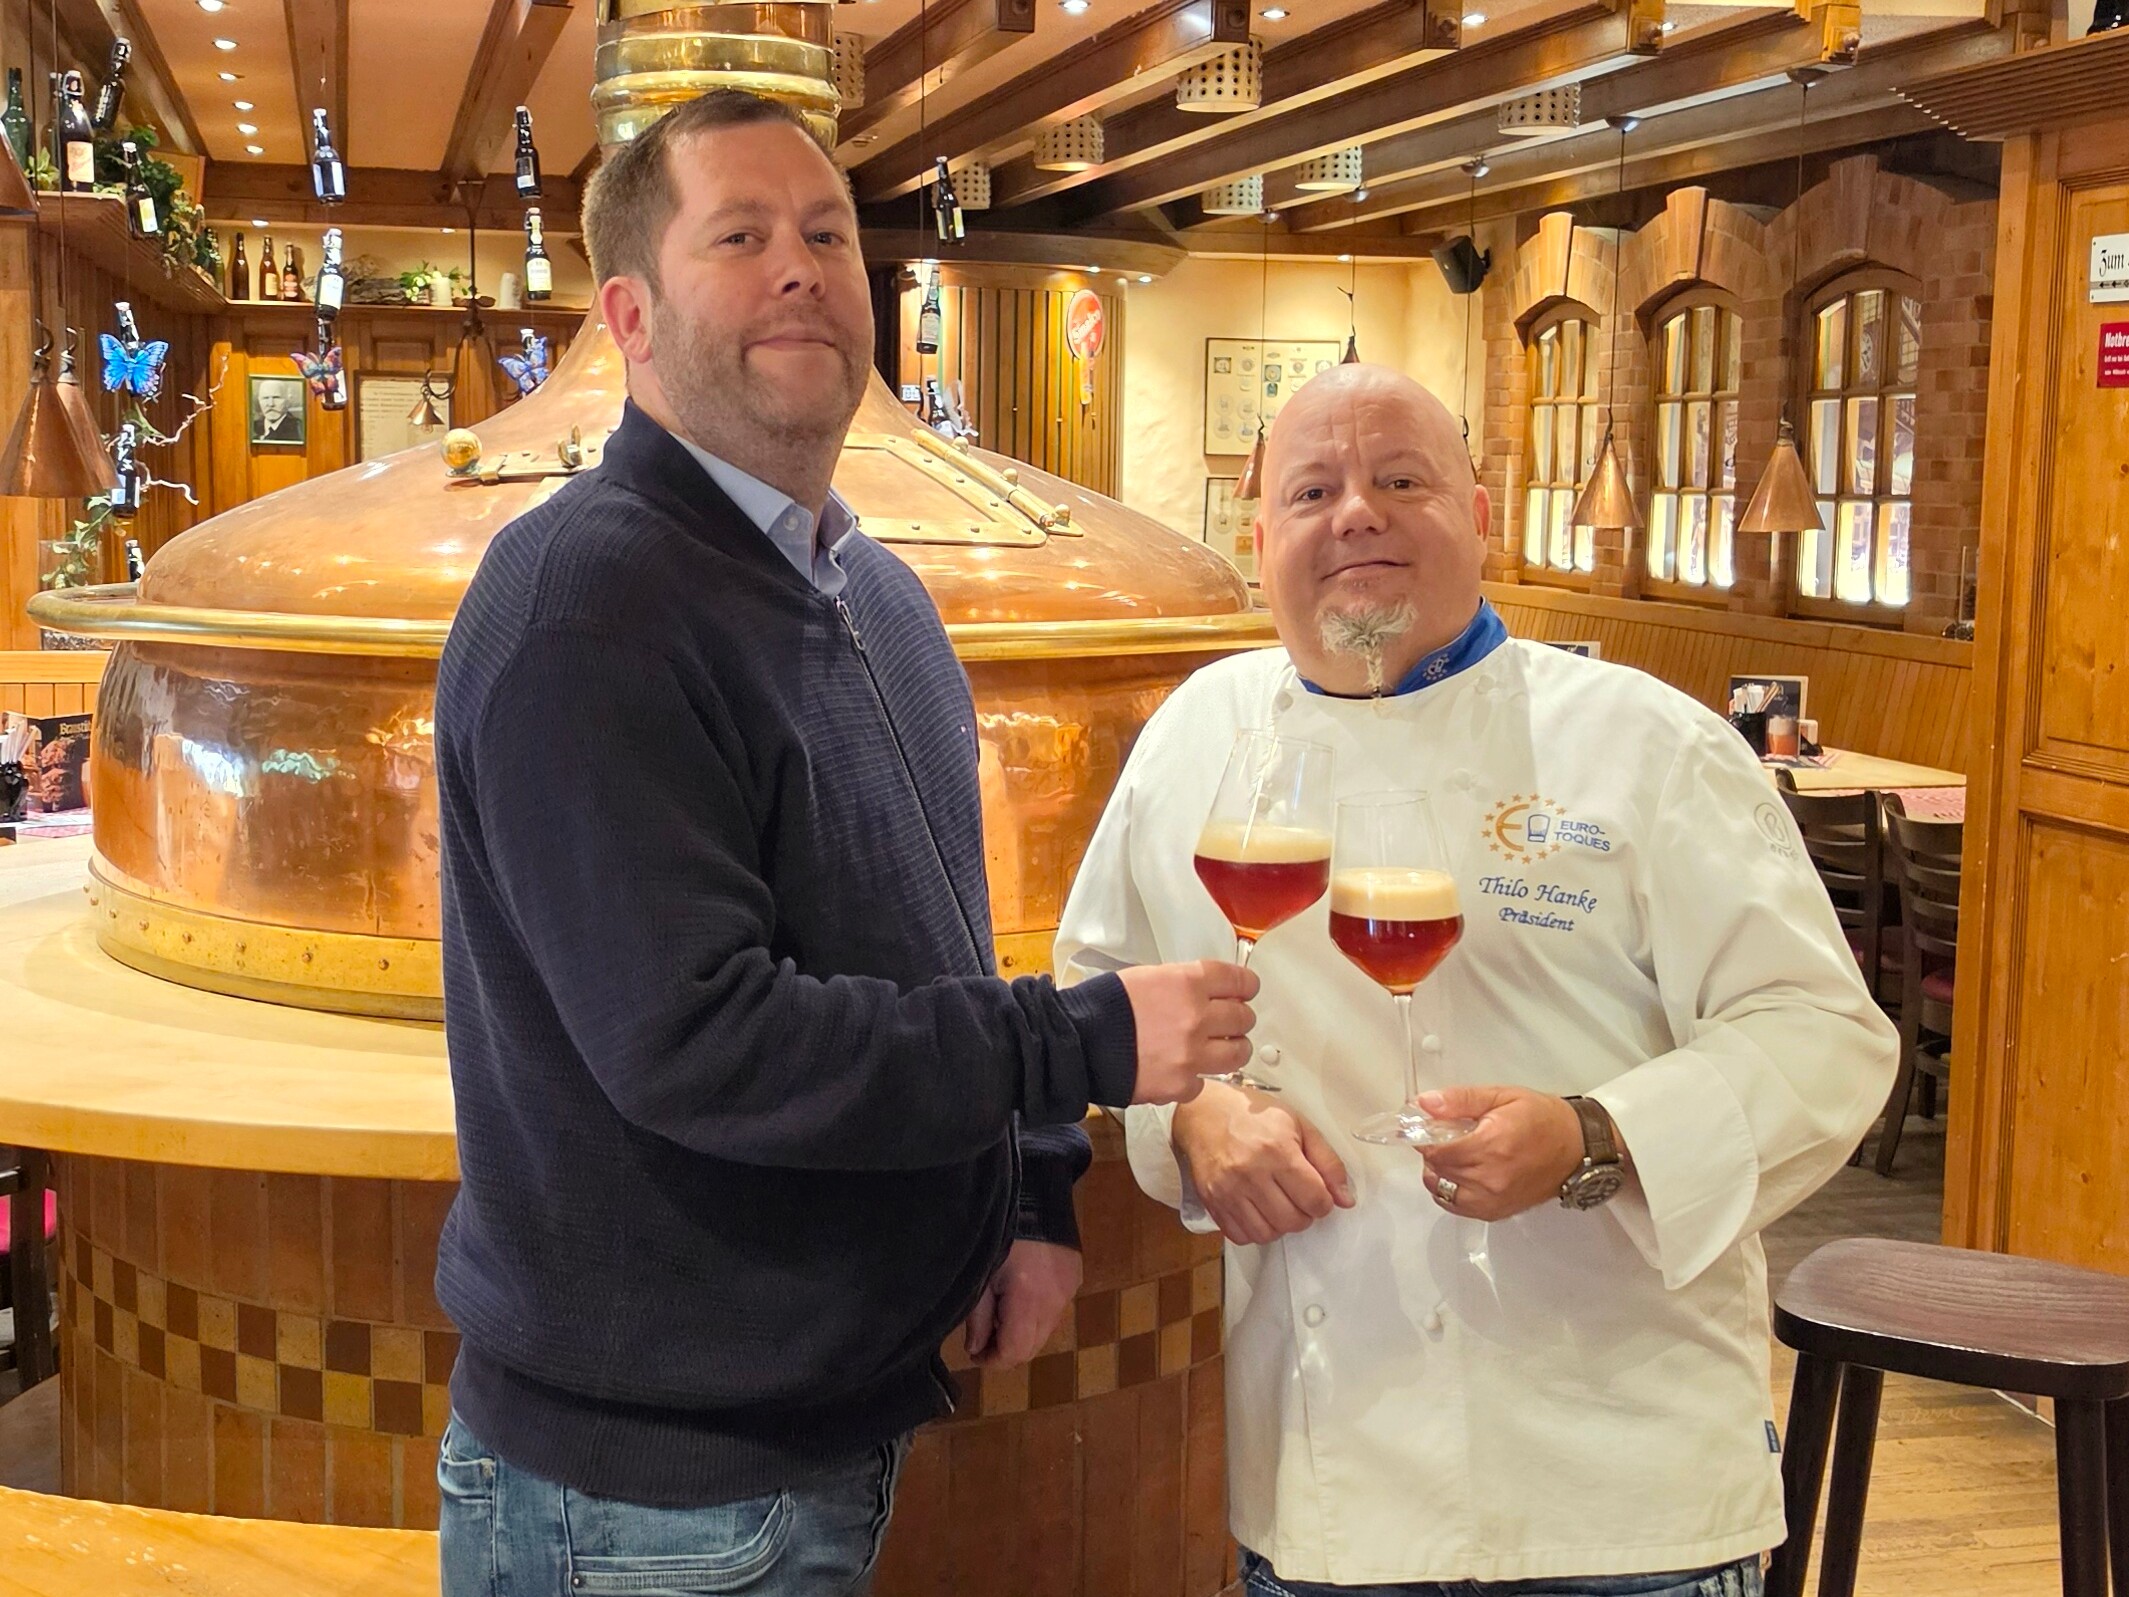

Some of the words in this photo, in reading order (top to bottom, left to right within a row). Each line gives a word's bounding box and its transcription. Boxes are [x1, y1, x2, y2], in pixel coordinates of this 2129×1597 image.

[2099, 249, 2125, 277] Zum
[1560, 820, 1606, 836] EURO-
[1554, 831, 1611, 852] TOQUES
[1479, 876, 1529, 898] Thilo
[1534, 884, 1598, 914] Hanke
[1499, 906, 1575, 932] Präsident
